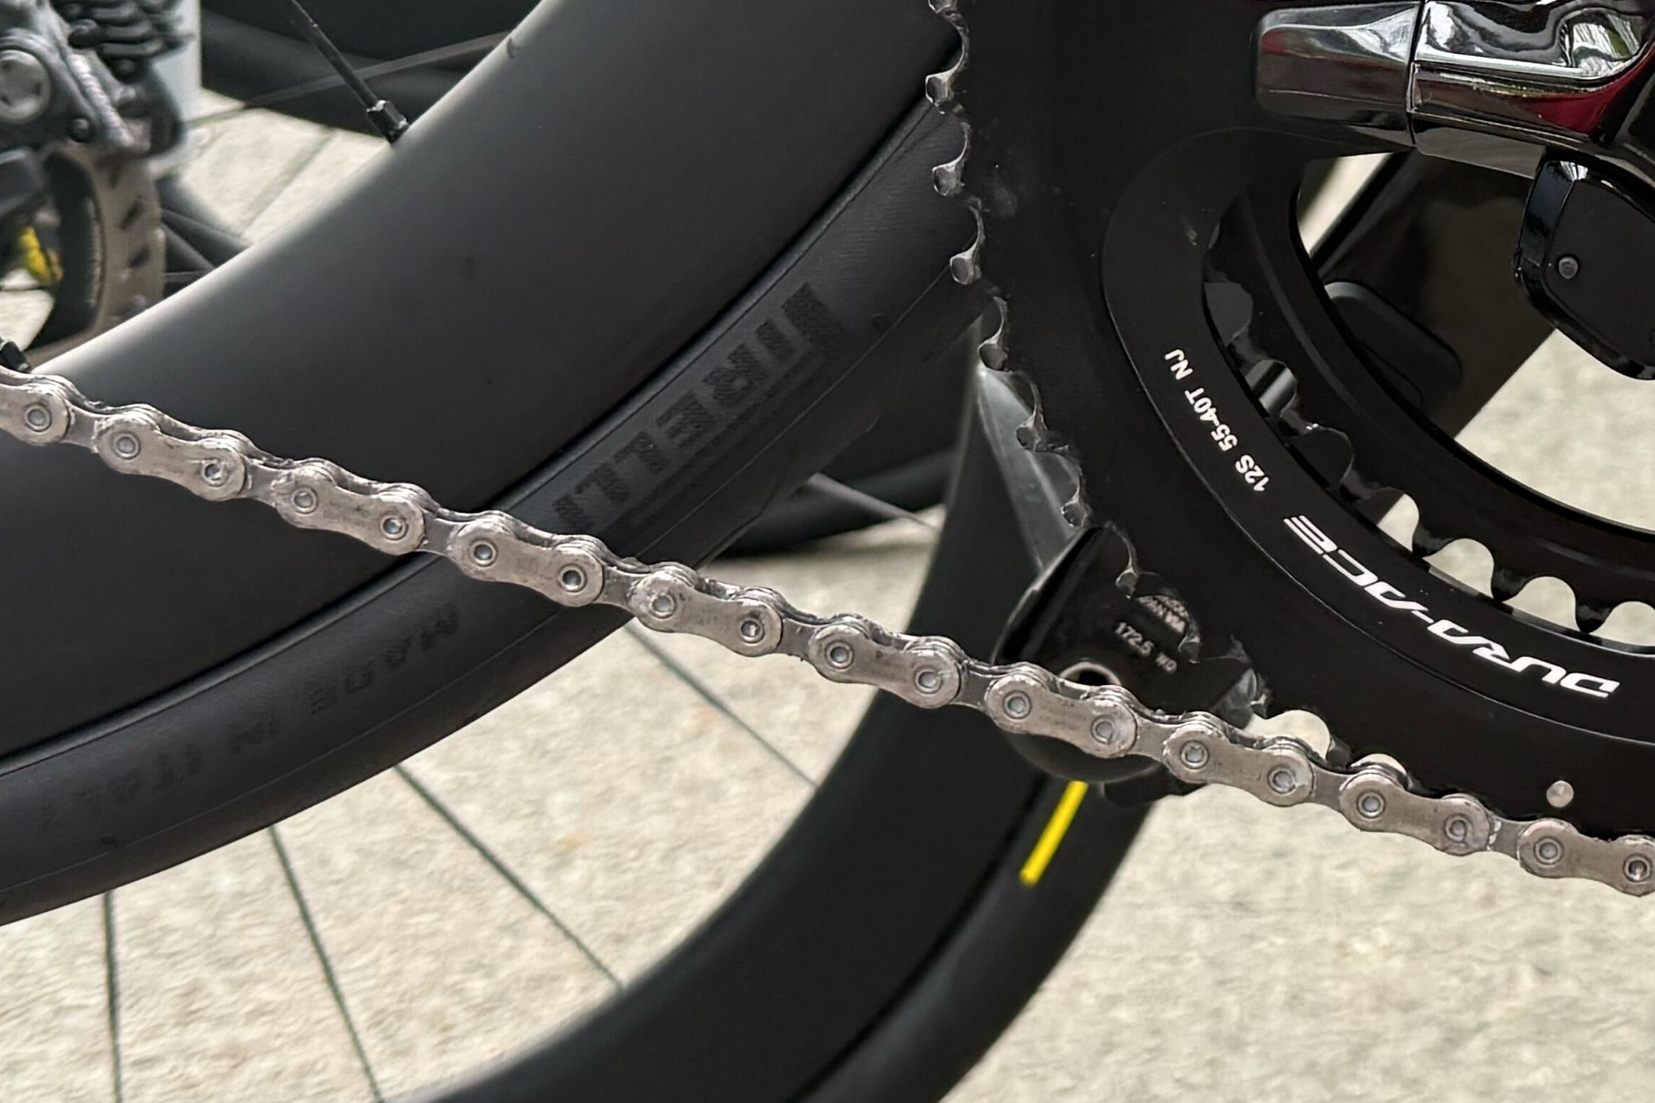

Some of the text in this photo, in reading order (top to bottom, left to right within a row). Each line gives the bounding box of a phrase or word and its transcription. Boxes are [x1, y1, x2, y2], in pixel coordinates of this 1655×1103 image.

[552, 282, 850, 536] PIRELLI
[1164, 349, 1269, 492] 12S 55-40T NJ
[308, 603, 459, 716] MADE
[1283, 515, 1620, 698] DURA-ACE
